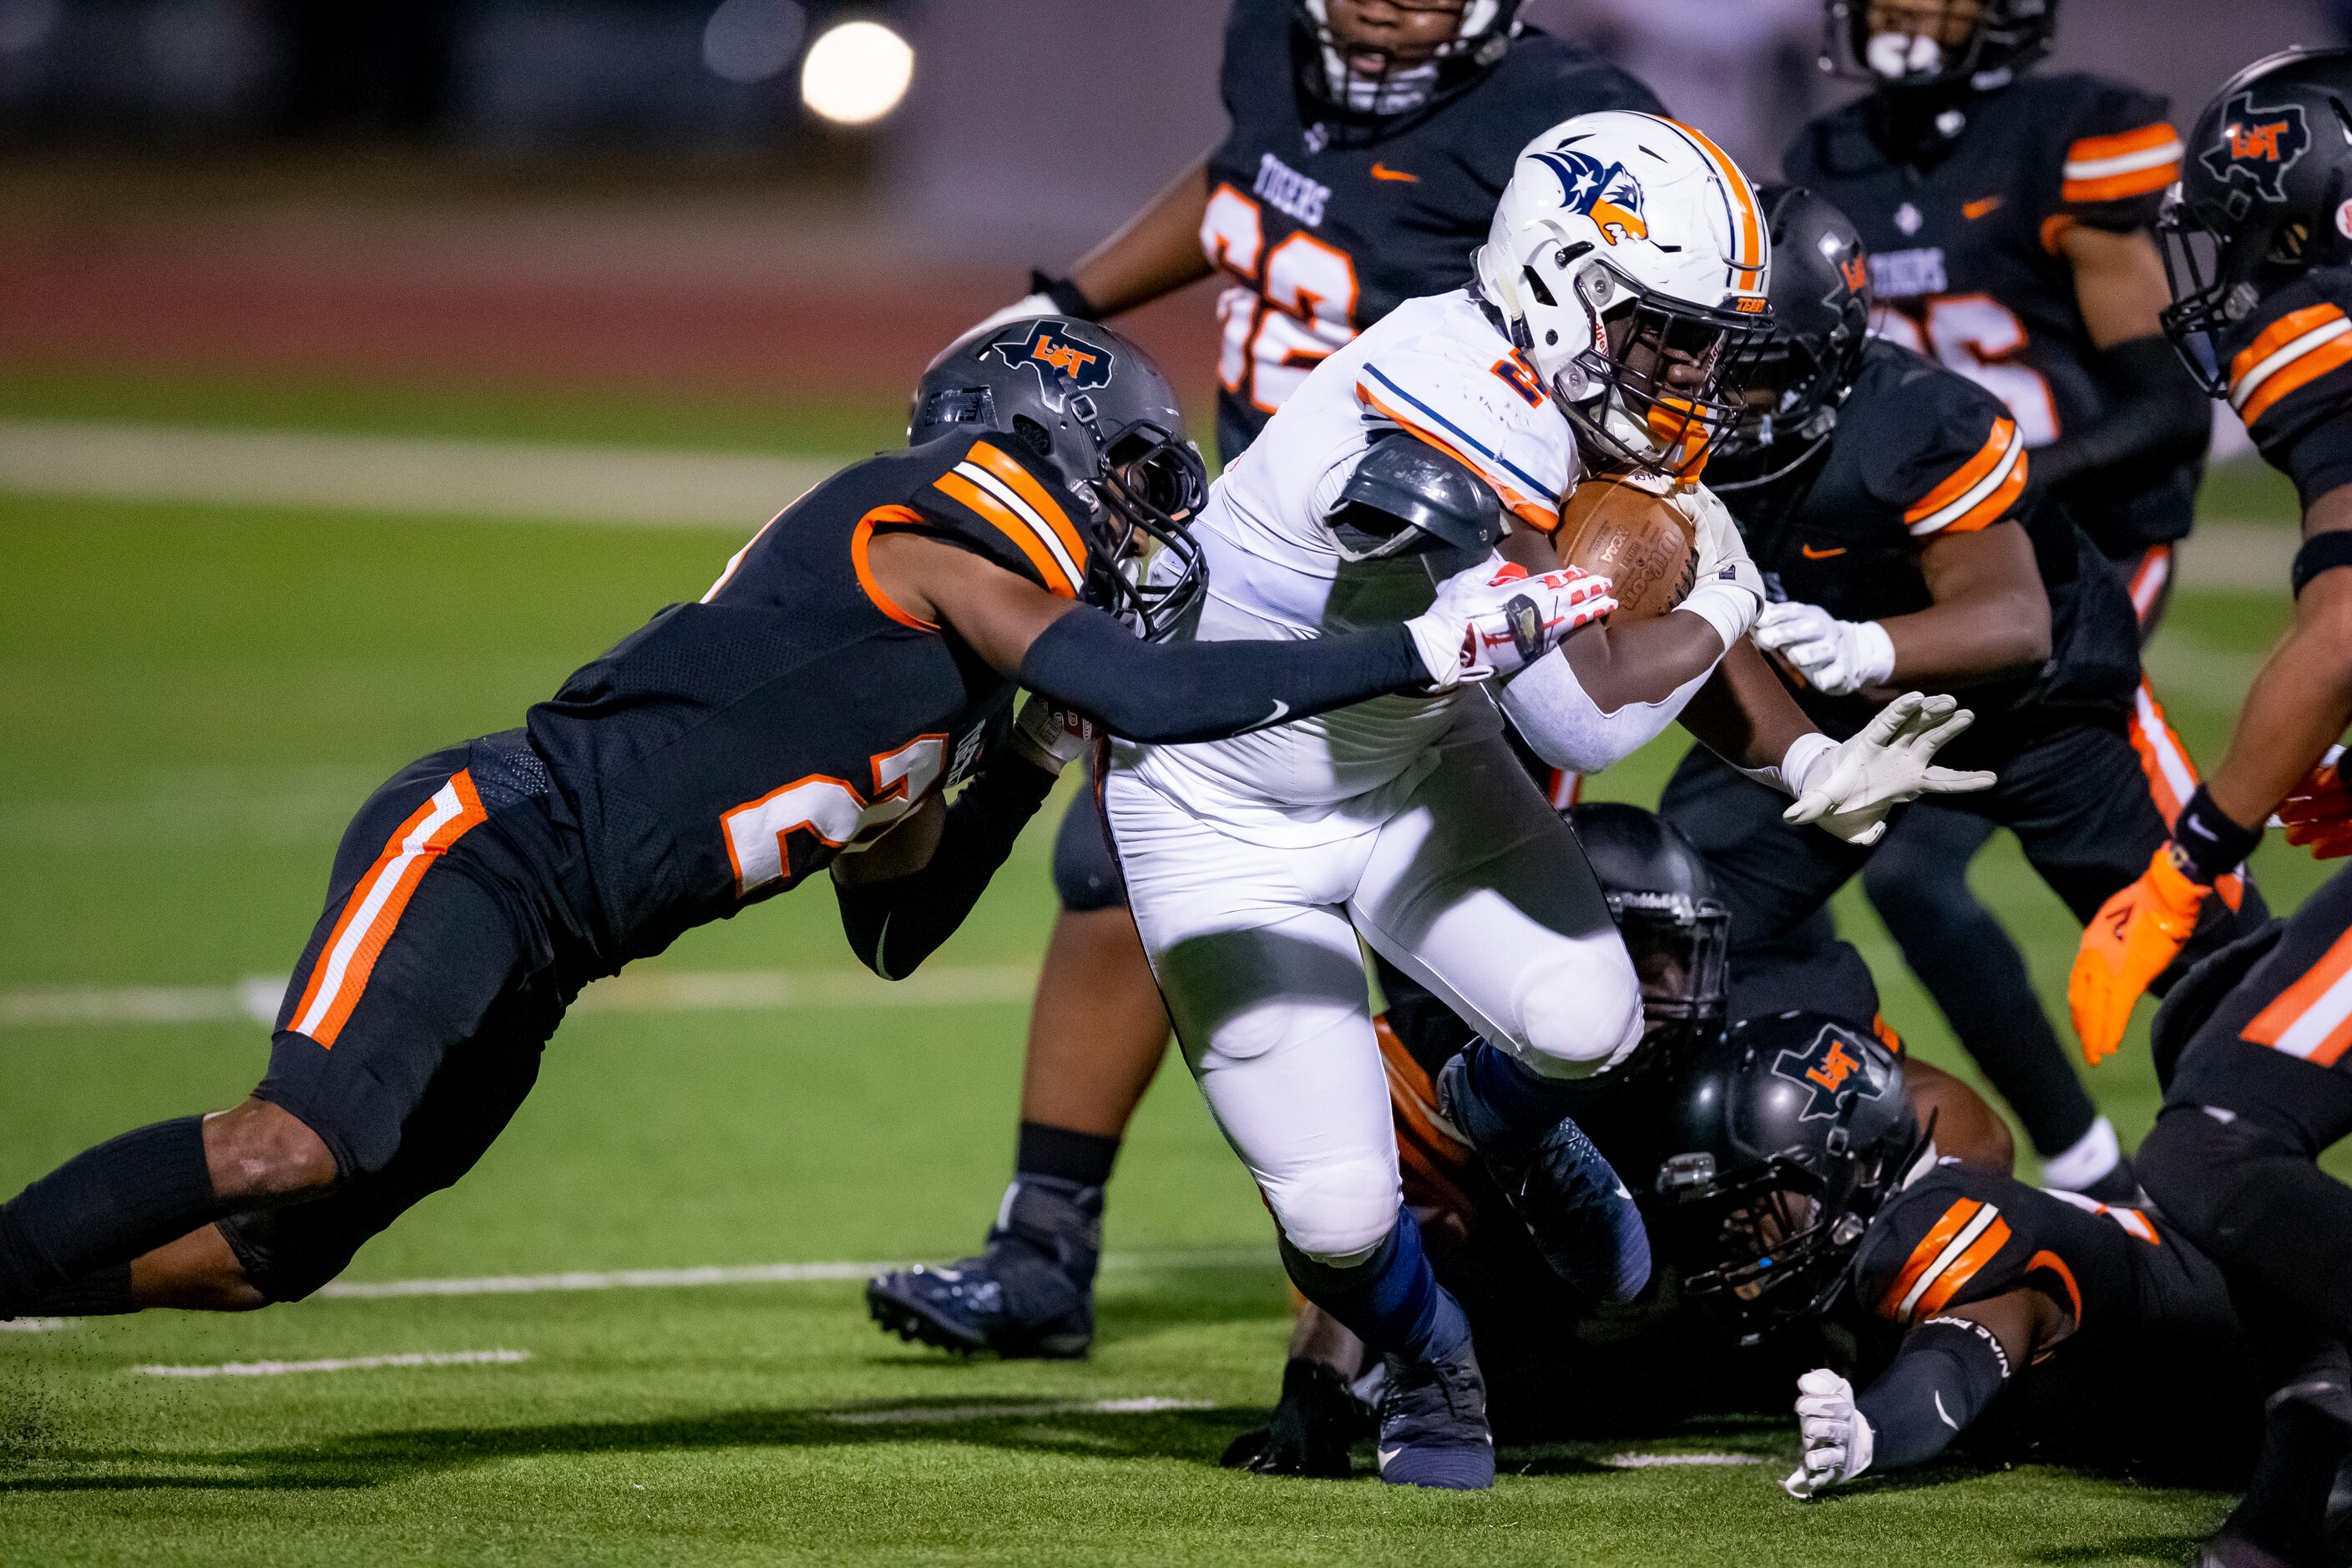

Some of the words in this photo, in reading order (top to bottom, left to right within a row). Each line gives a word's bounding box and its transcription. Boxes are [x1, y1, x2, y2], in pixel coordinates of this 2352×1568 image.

[1253, 153, 1332, 227] TIGERS
[1621, 529, 1685, 610] Wilson
[1975, 1324, 2011, 1378] NIKE
